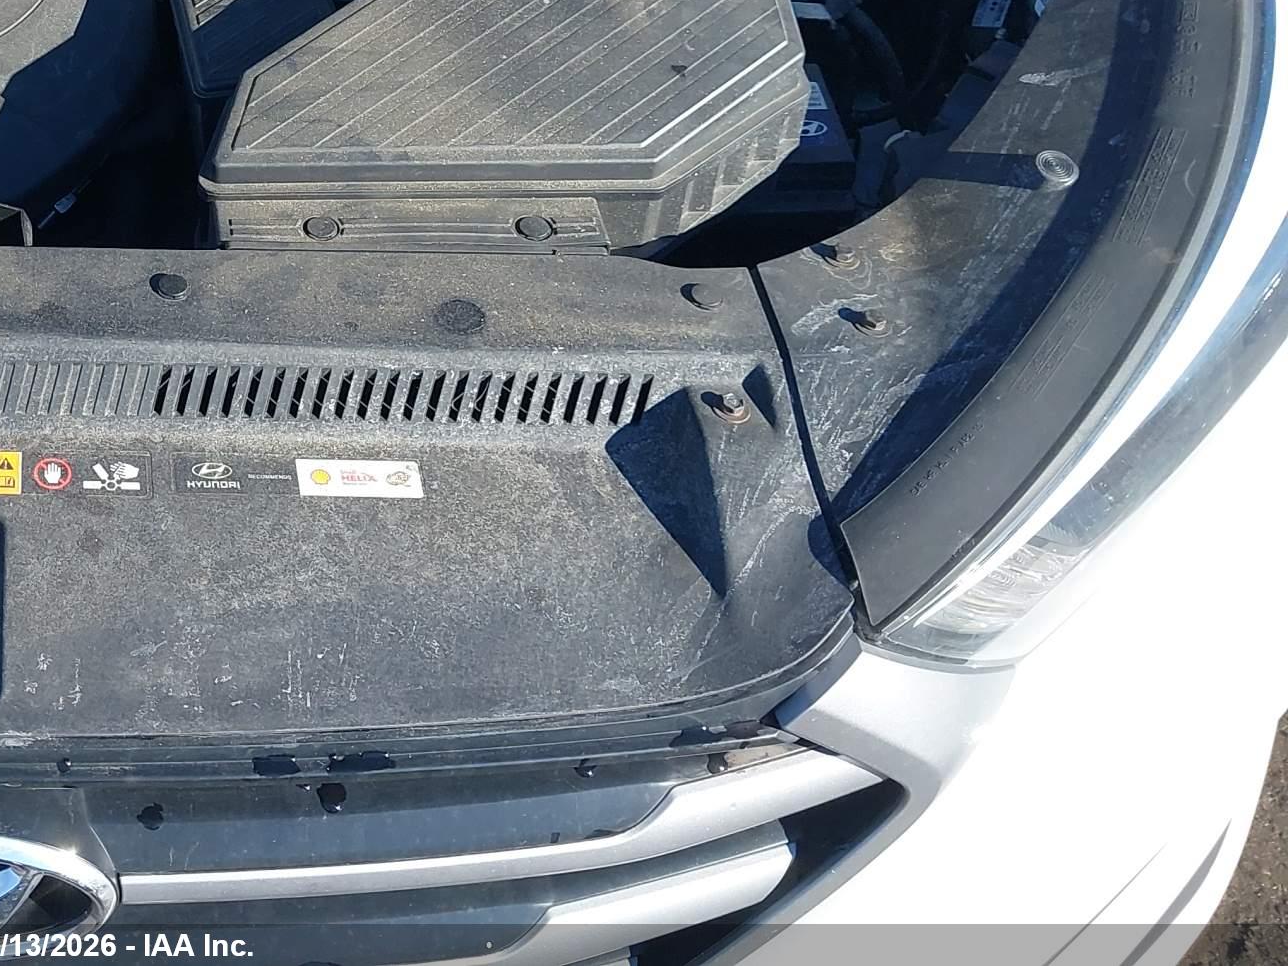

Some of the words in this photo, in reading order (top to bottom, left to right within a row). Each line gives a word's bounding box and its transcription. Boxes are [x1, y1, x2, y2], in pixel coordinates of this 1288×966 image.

[247, 473, 292, 481] RECOMMENDS
[341, 474, 378, 483] HELIX
[186, 480, 241, 490] HYUNDAI
